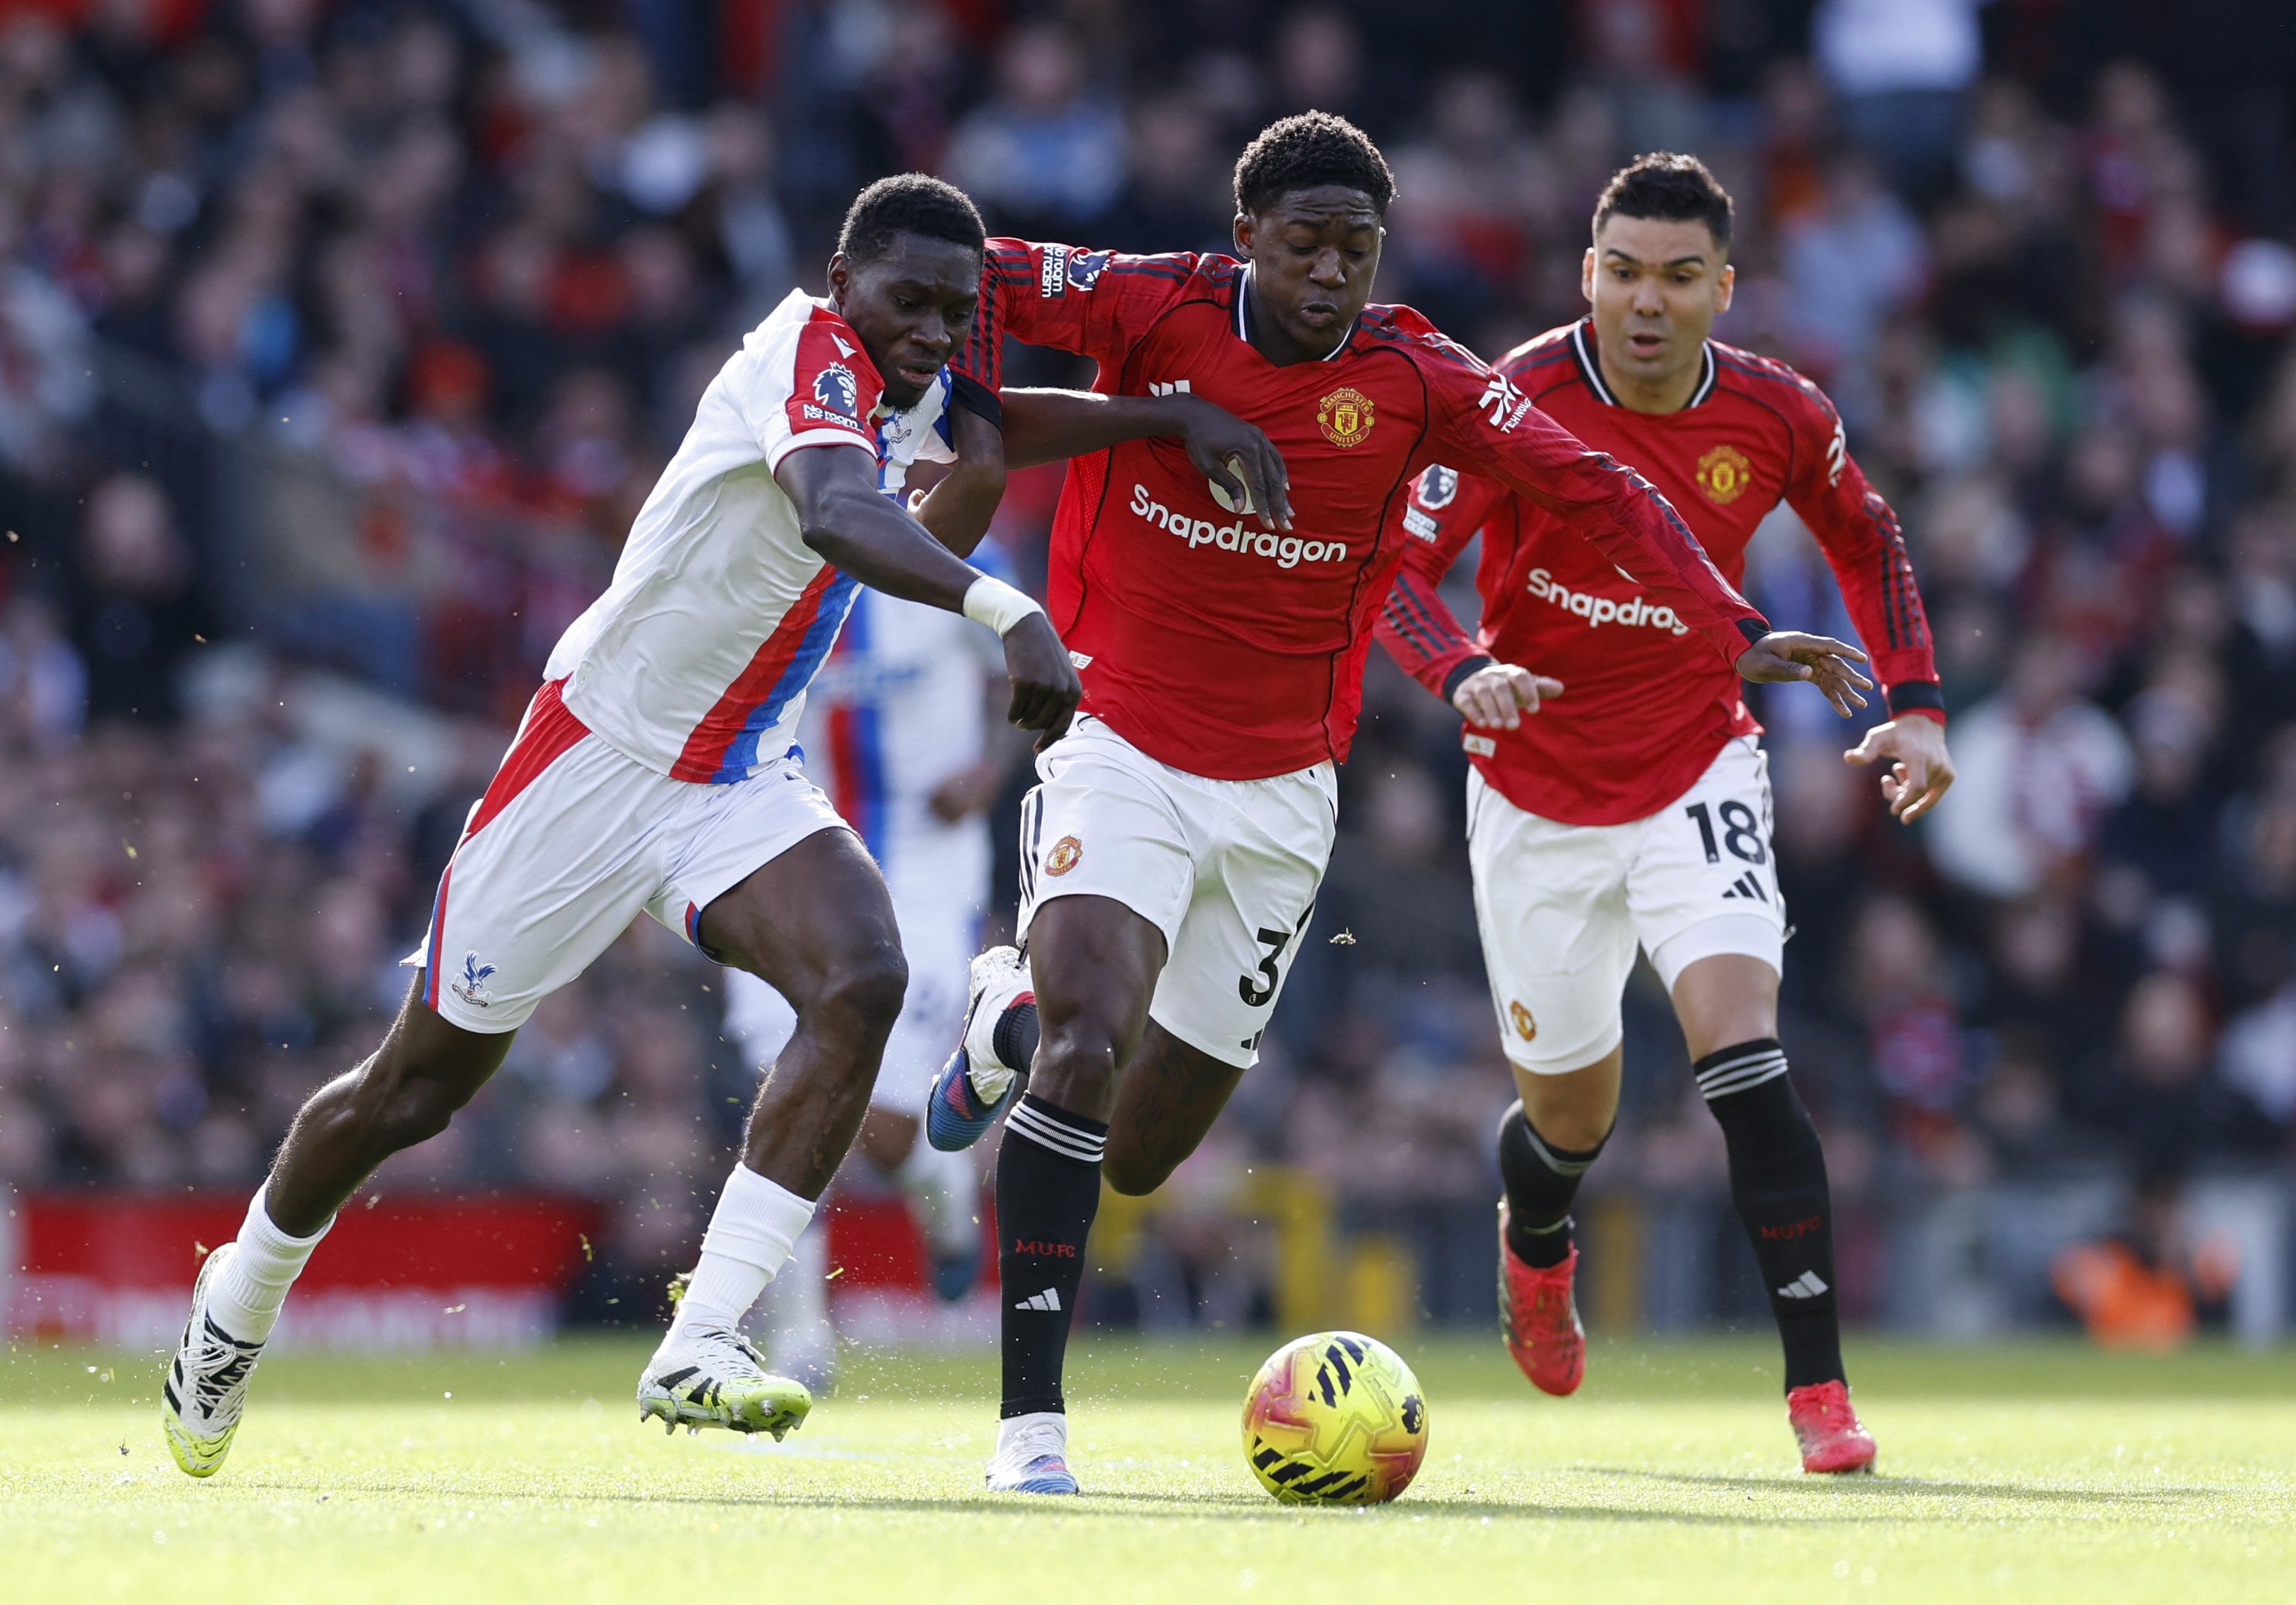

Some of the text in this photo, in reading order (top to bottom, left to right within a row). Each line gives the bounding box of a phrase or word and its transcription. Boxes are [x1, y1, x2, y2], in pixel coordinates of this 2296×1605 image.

[1041, 256, 1053, 298] racism
[1053, 258, 1064, 292] room
[1323, 391, 1370, 413] MANCHESTER
[824, 410, 858, 429] room
[1329, 432, 1362, 443] UNITED
[1130, 483, 1346, 569] Snapdragon
[1526, 568, 1690, 636] Snapdrag
[1686, 800, 1766, 866] 18
[1015, 1238, 1077, 1258] MUFC
